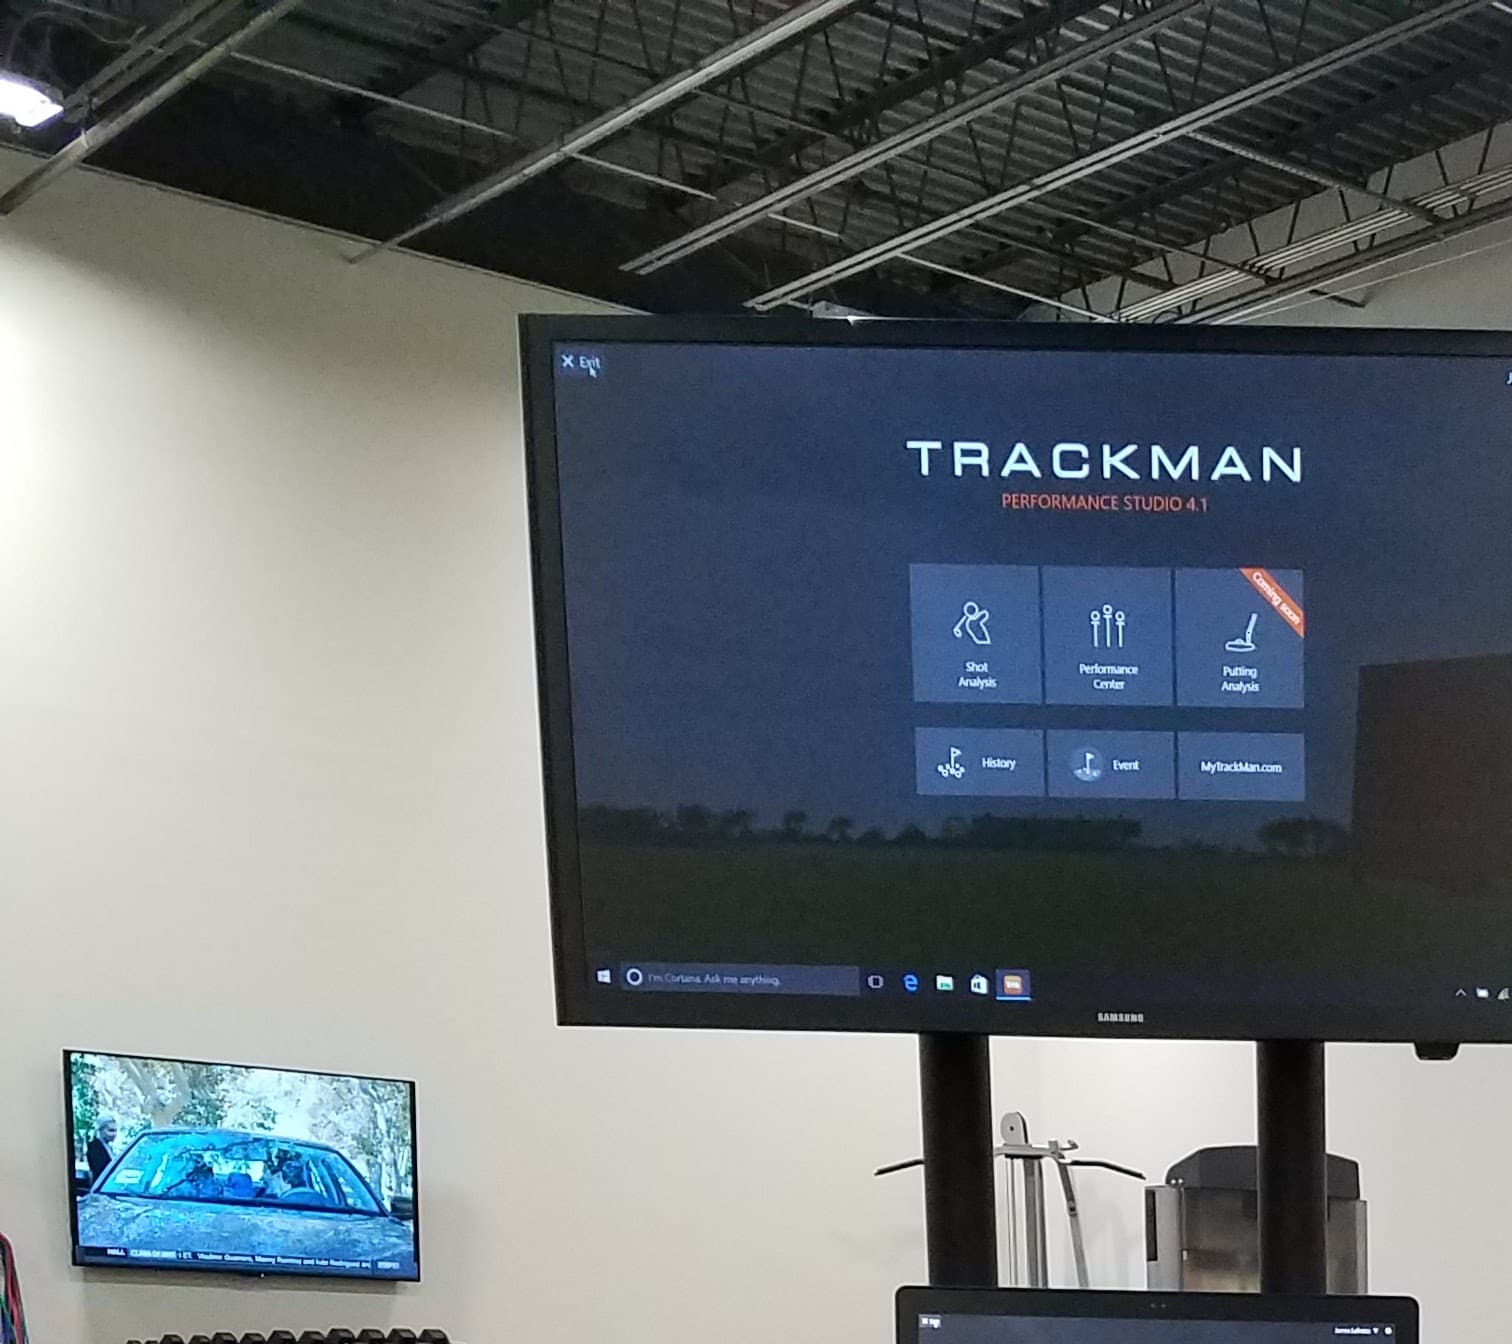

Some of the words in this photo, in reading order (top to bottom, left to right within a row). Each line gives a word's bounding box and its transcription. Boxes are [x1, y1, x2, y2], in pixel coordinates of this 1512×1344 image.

[906, 440, 1302, 482] TRACKMAN
[1002, 493, 1118, 511] PERFORMANCE
[1123, 495, 1182, 512] STUDIO
[1186, 497, 1208, 513] 4.1
[1252, 571, 1282, 607] Coming
[1280, 602, 1301, 625] soon
[965, 661, 988, 673] Shot
[1079, 663, 1138, 676] Performance
[1223, 665, 1257, 679] Putting
[958, 676, 997, 690] Analysis
[1093, 679, 1125, 690] Center
[1221, 680, 1259, 694] Analysis
[982, 757, 1016, 771] History
[1113, 759, 1139, 771] Event
[1200, 761, 1283, 774] MyTrackMan.com
[1097, 1012, 1144, 1023] SAMSUNG
